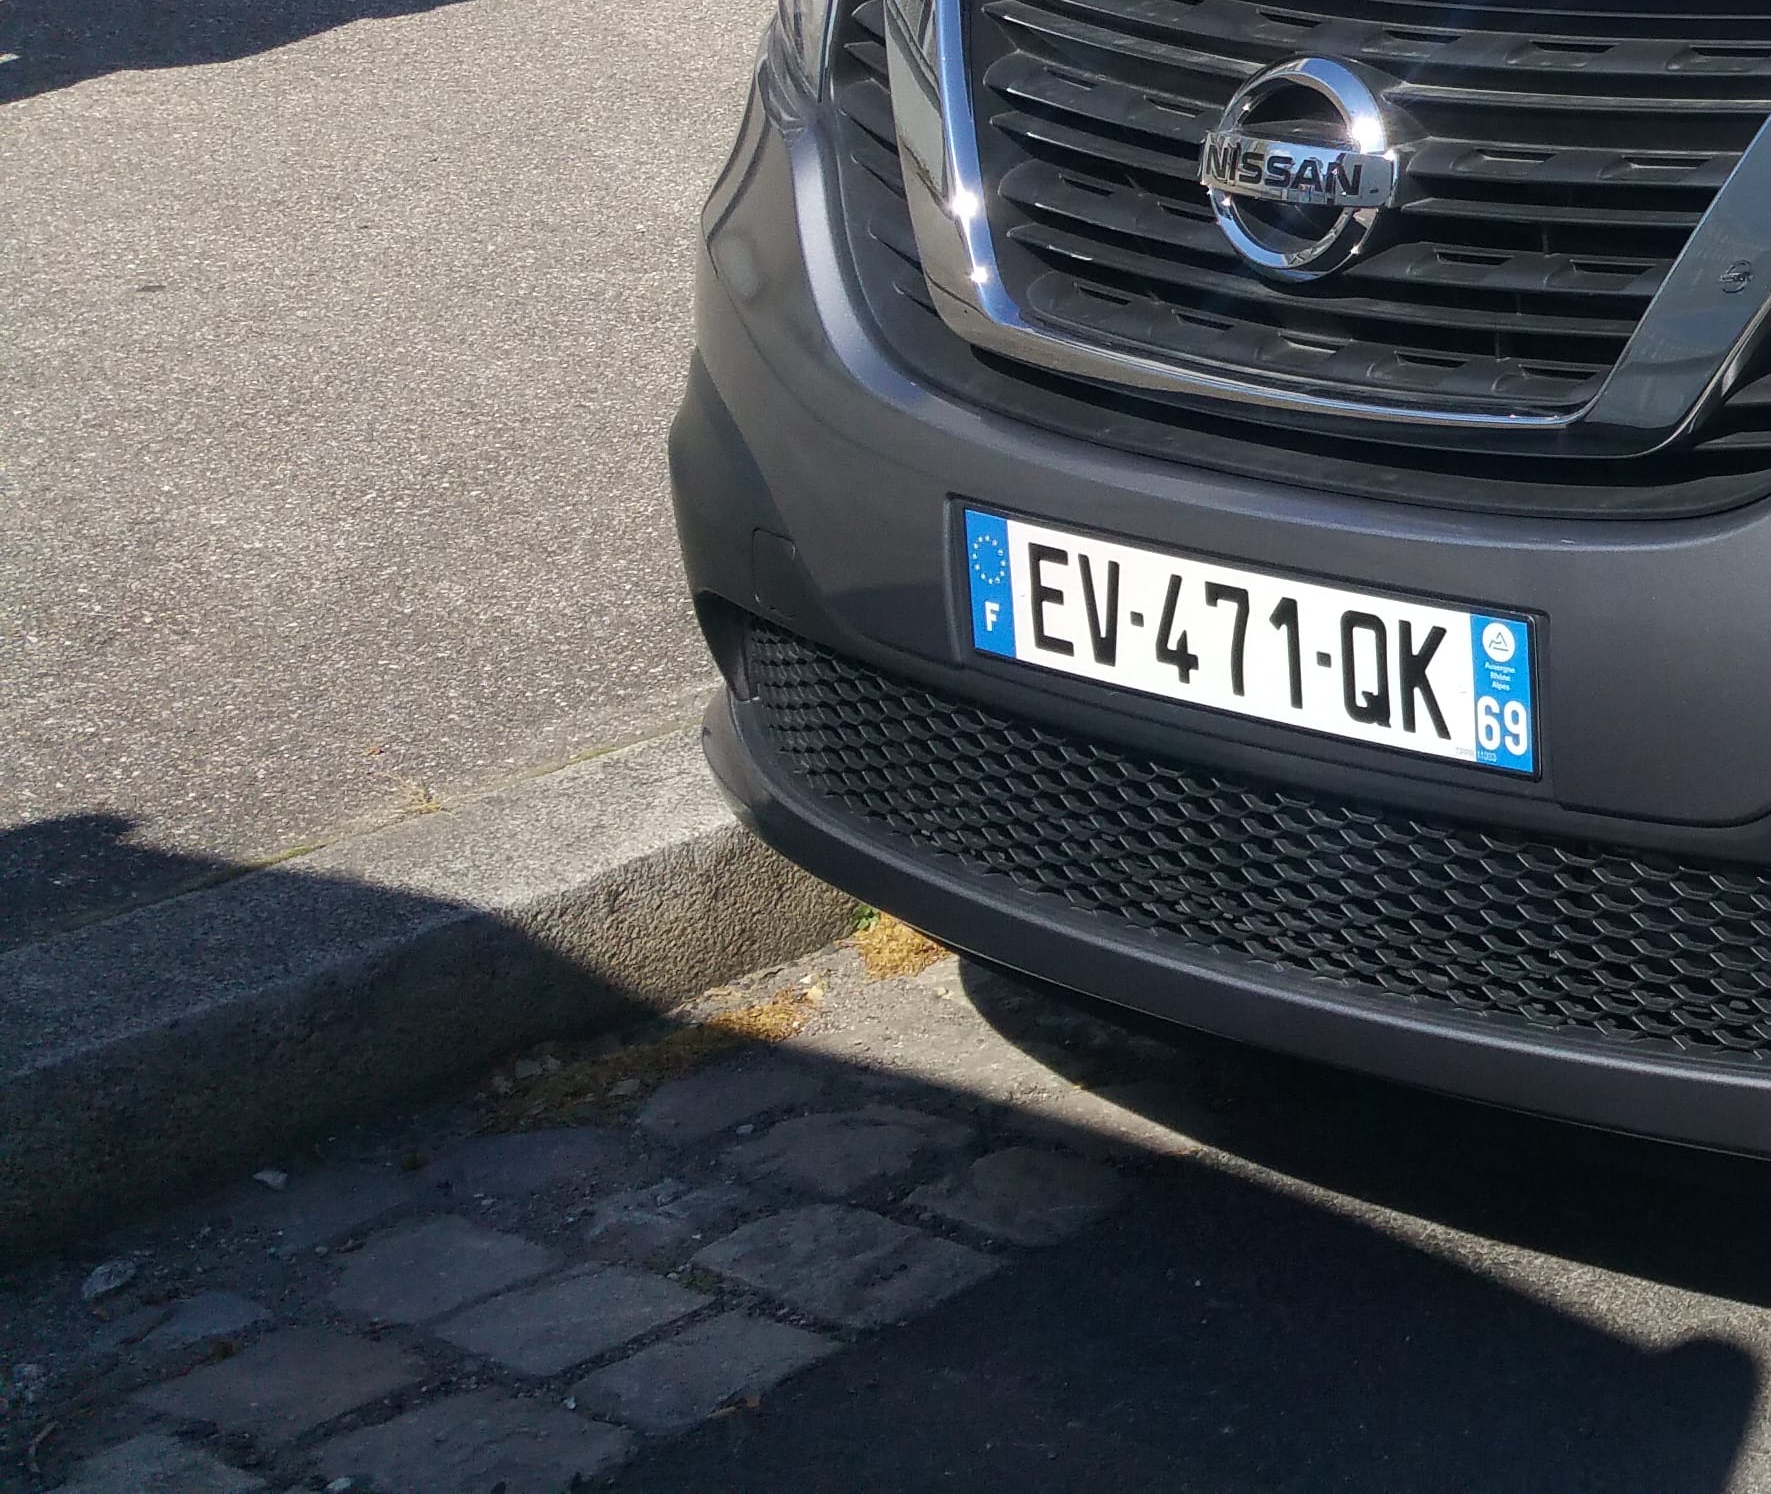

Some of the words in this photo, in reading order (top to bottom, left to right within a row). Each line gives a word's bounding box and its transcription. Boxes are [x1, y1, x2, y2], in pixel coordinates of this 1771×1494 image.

[1205, 138, 1362, 196] NISSAN
[984, 601, 1000, 632] F
[1028, 542, 1451, 741] EV-471-QK
[1477, 695, 1528, 756] 69
